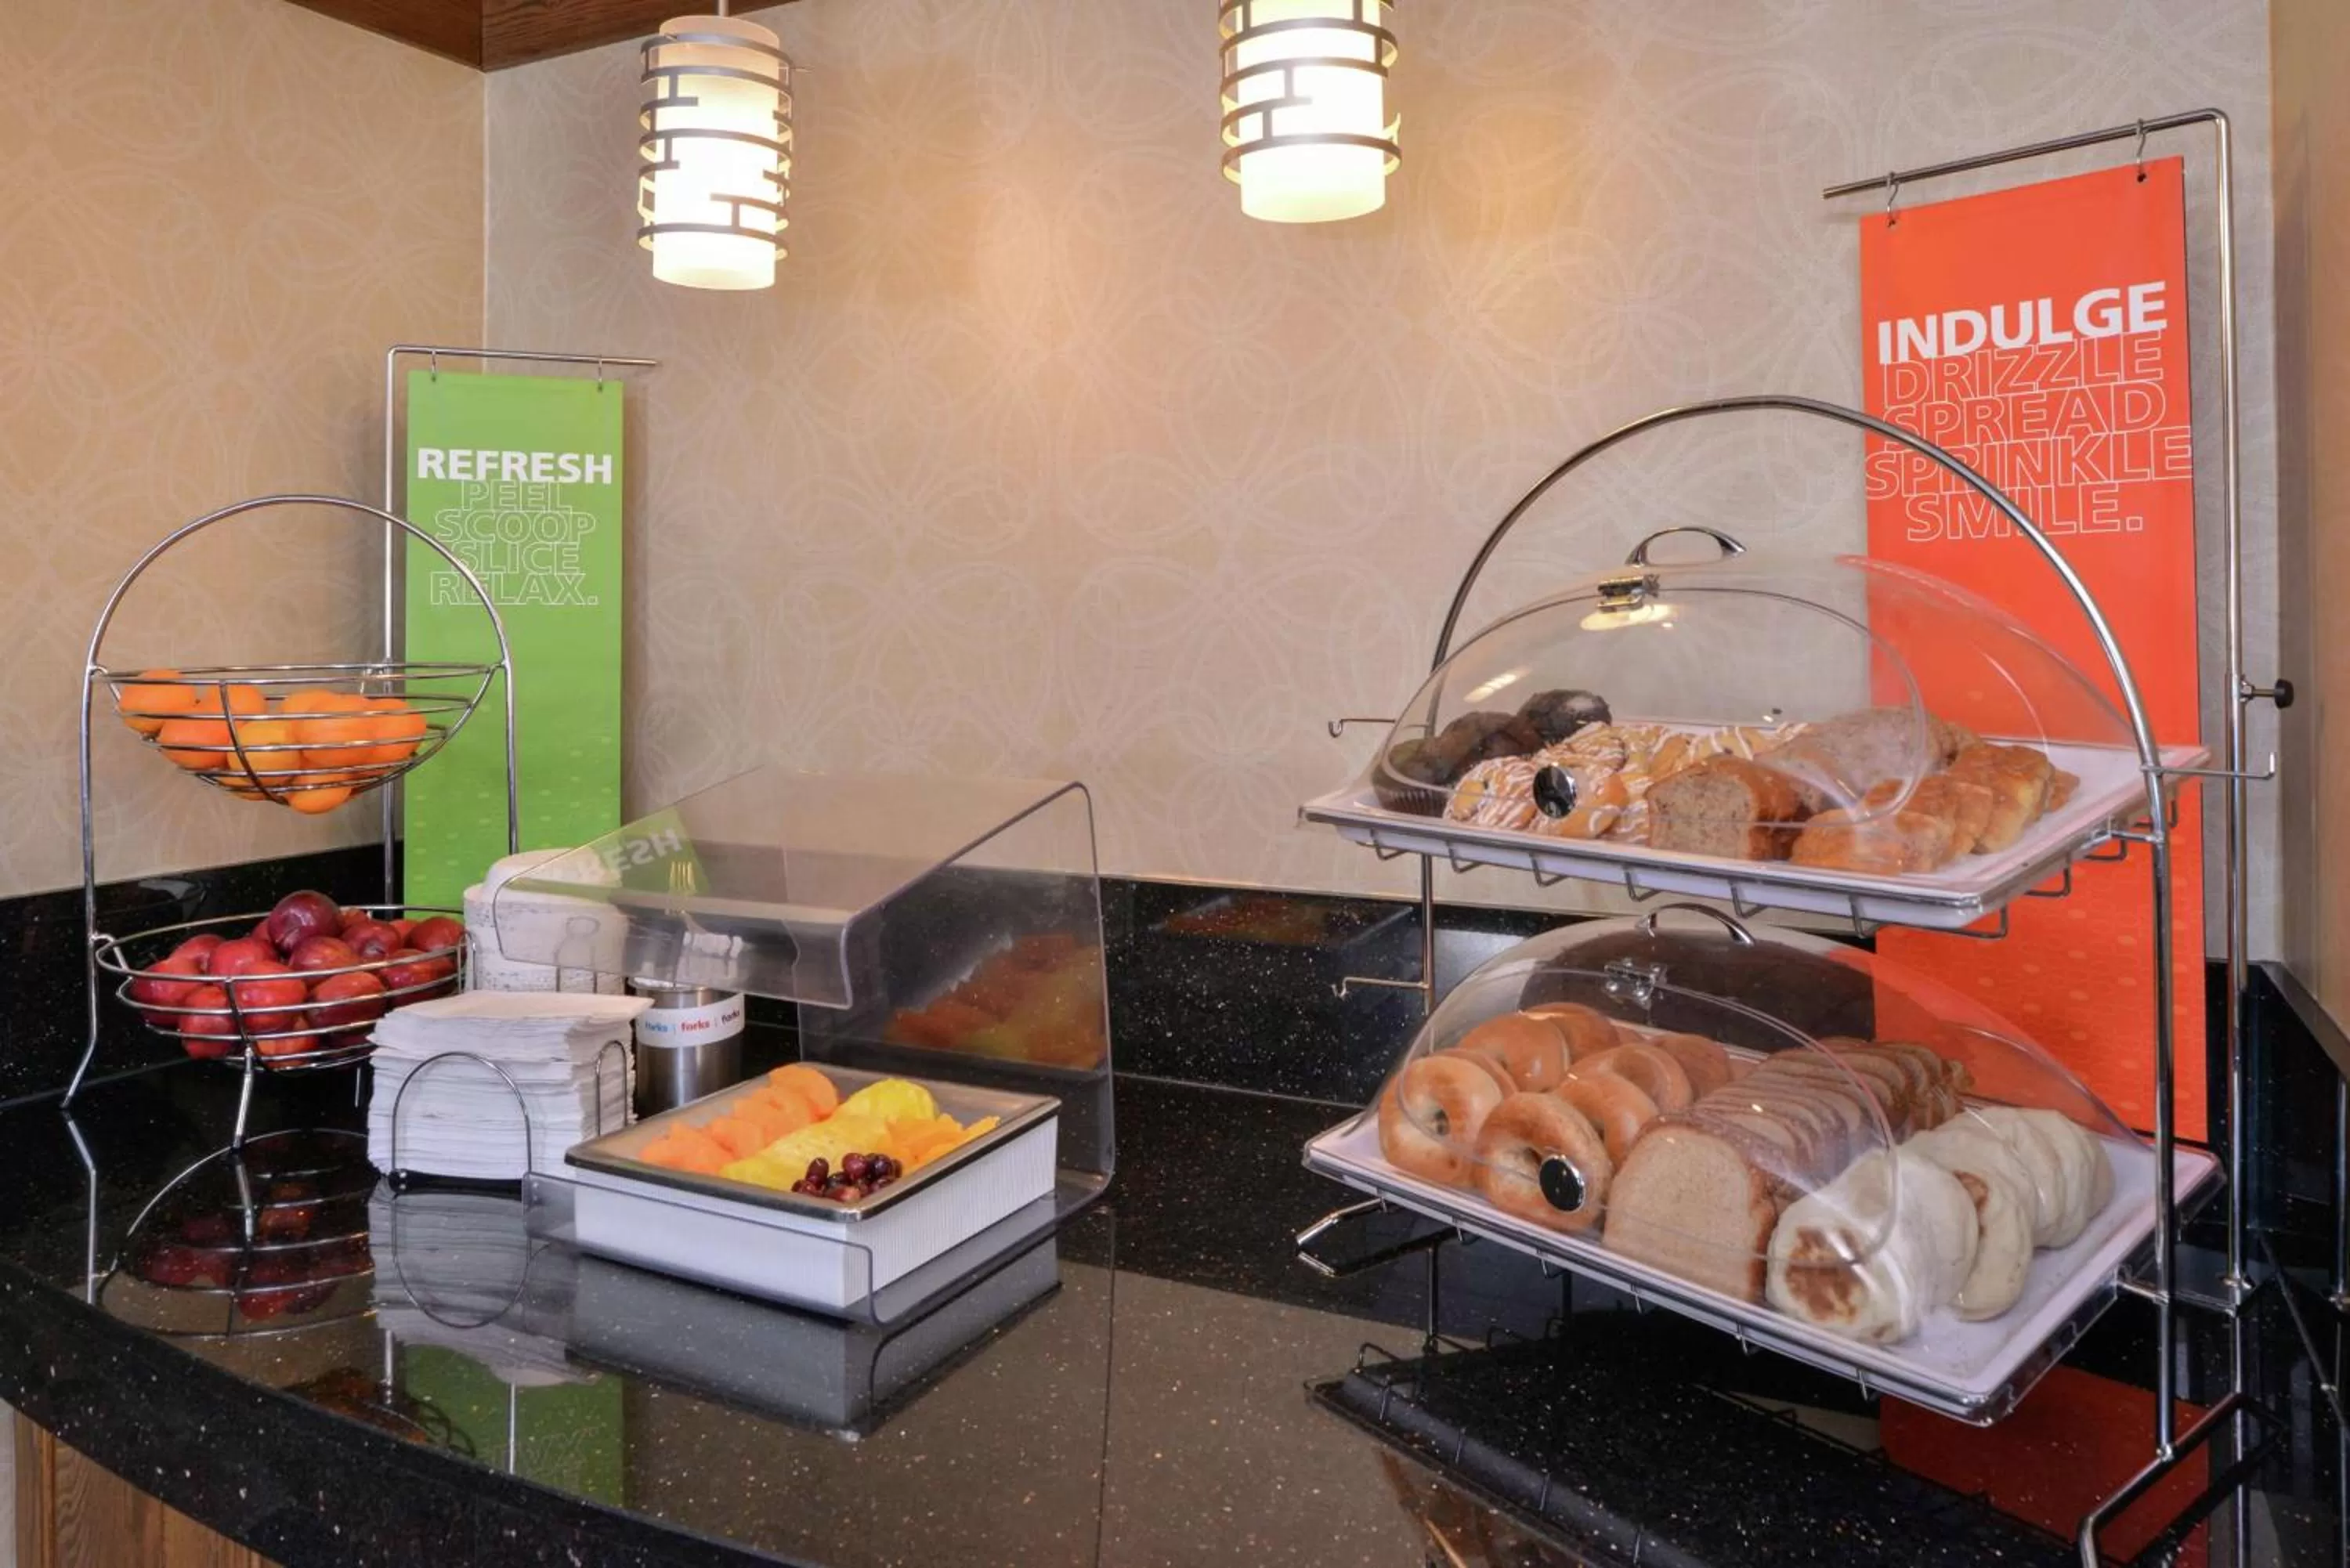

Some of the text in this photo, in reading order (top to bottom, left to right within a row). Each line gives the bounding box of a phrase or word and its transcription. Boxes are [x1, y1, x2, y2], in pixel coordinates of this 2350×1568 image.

[1878, 280, 2167, 364] INDULGE
[1884, 330, 2164, 408] DRIZZLE
[1882, 381, 2166, 452] SPREAD
[418, 447, 612, 484] REFRESH
[1864, 425, 2193, 500] SPRINKLE
[461, 479, 573, 511] PEEL
[434, 509, 596, 544] SCOOP
[451, 541, 580, 574] SLICE
[431, 571, 599, 605] RELAX.
